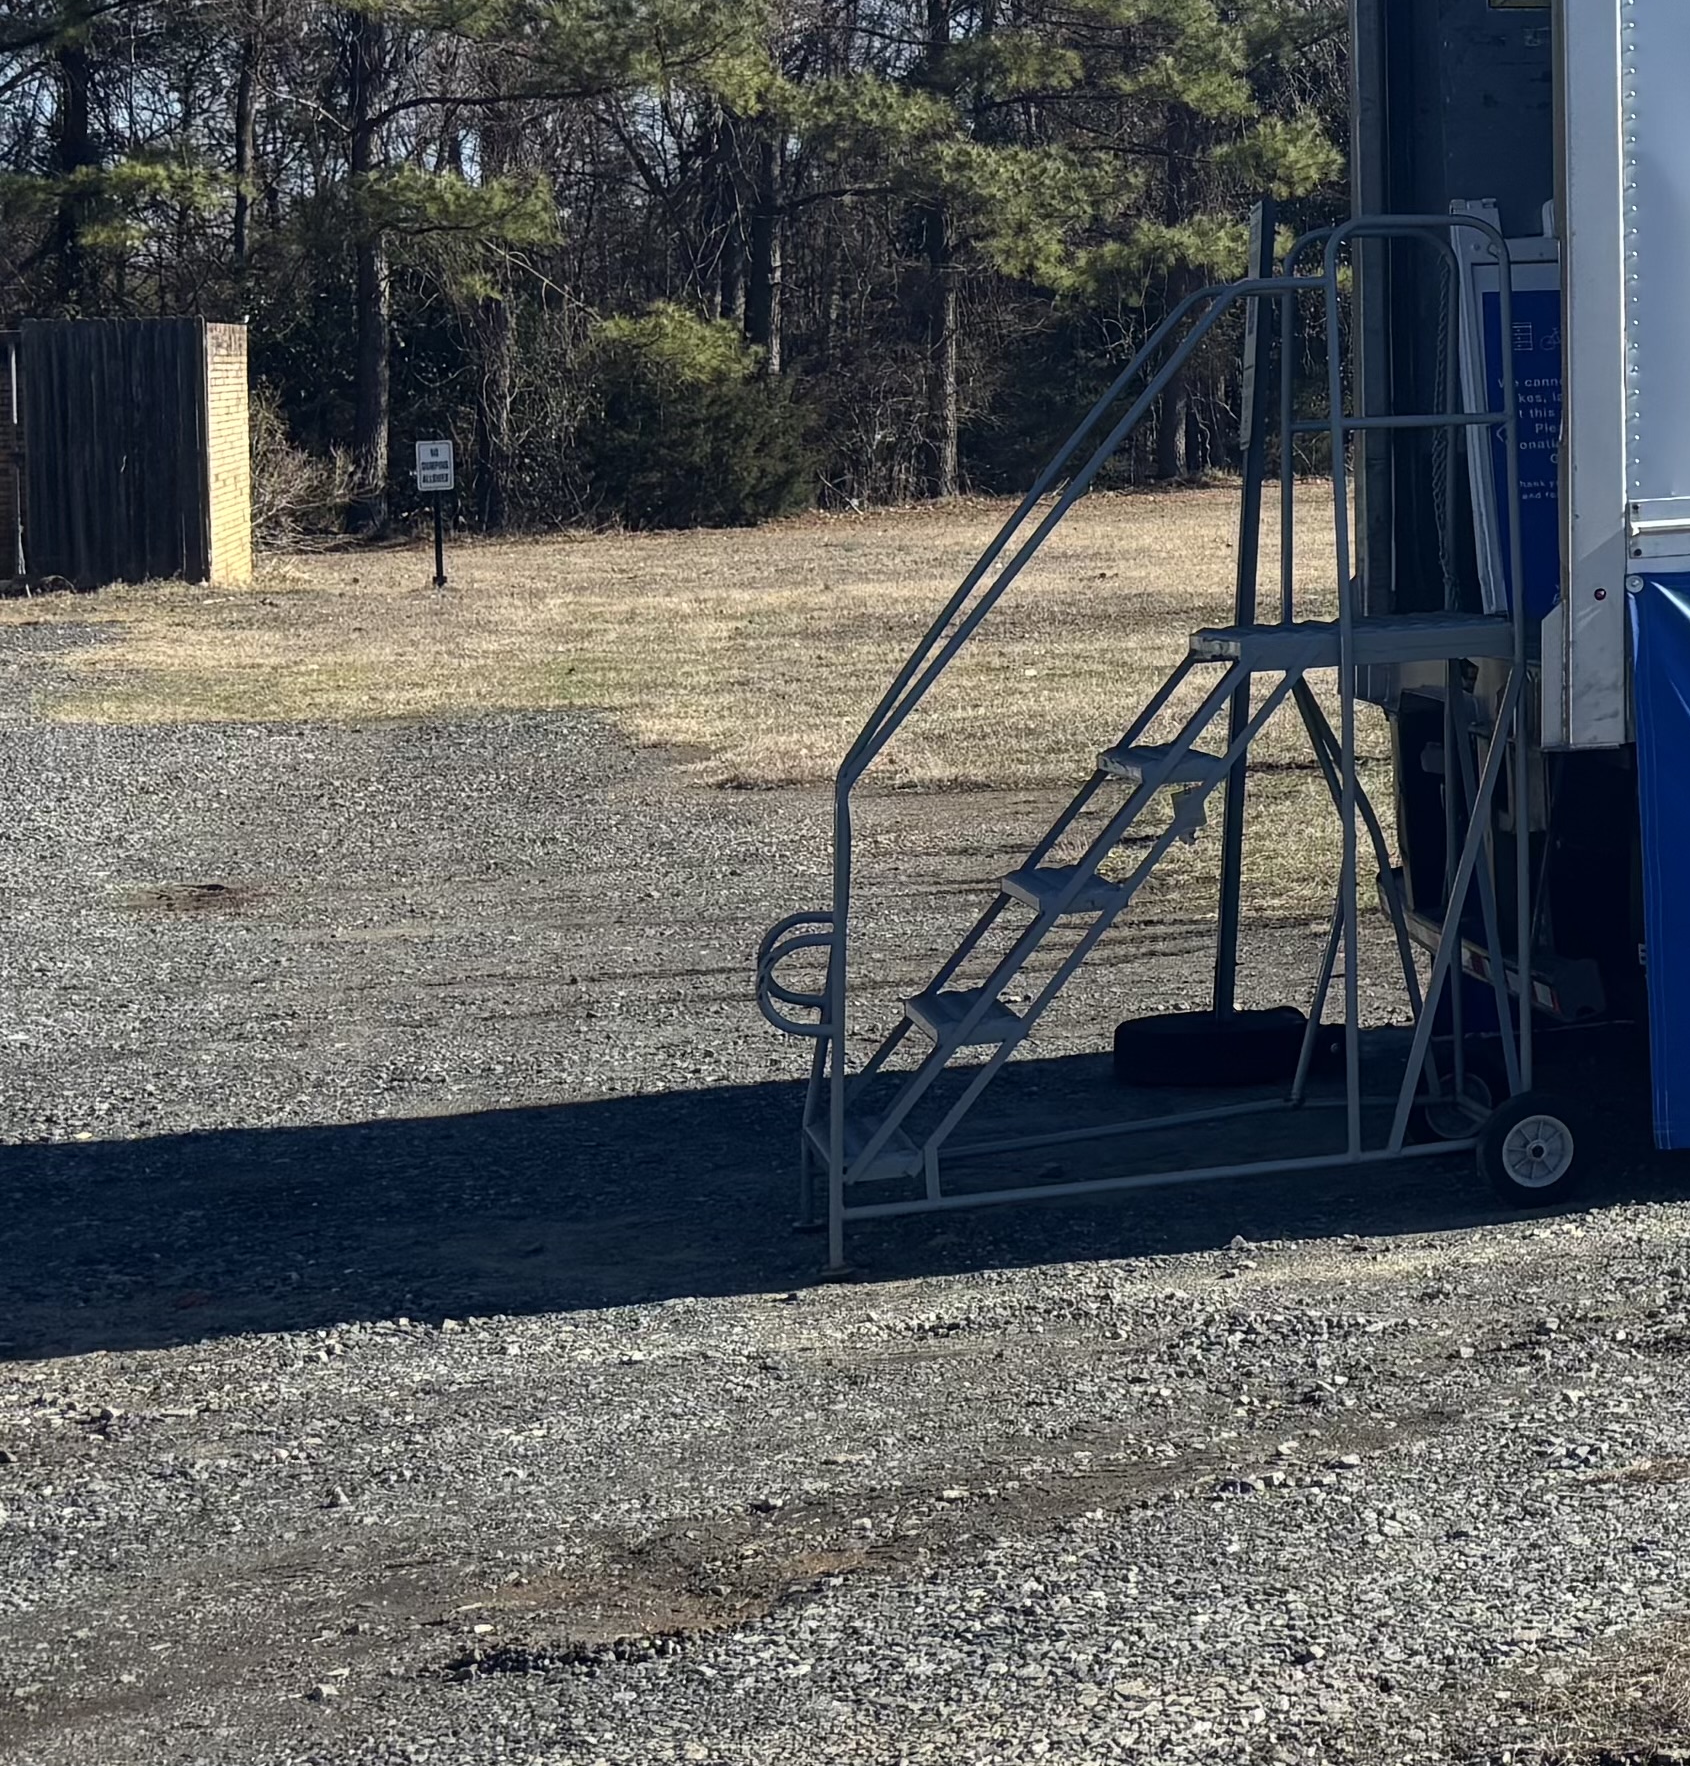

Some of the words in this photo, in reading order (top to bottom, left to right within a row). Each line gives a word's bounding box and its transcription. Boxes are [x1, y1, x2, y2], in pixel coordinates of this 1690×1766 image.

[1524, 378, 1562, 388] cann
[1535, 421, 1557, 434] Ple
[1519, 438, 1560, 450] onati
